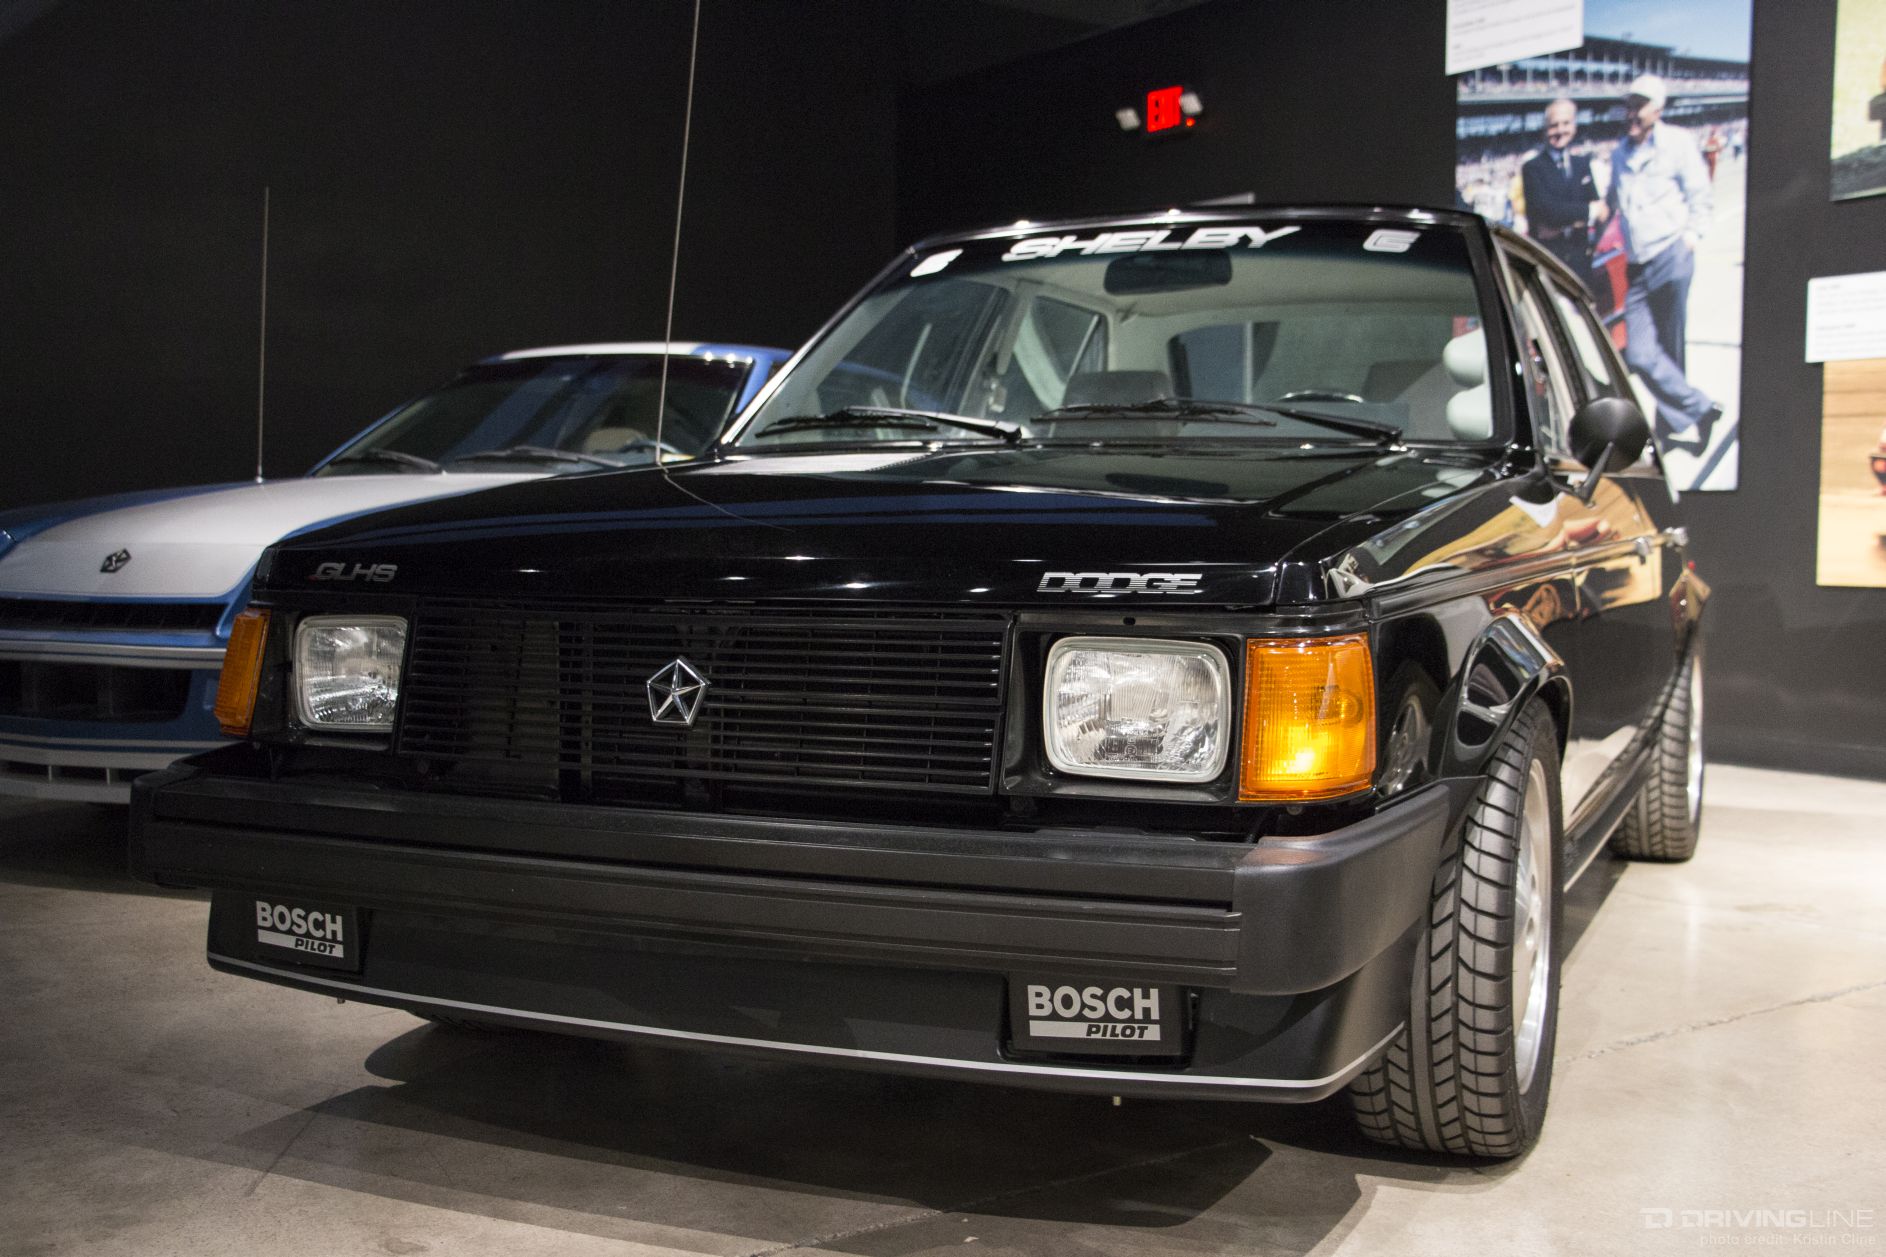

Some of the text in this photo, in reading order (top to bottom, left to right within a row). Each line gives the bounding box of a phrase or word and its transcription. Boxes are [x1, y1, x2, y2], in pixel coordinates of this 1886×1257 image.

[1001, 226, 1301, 262] SHELBY
[315, 562, 398, 582] GLHS
[1036, 571, 1203, 595] DODGE
[256, 900, 343, 941] BOSCH
[294, 937, 336, 955] PILOT
[1027, 984, 1160, 1020] BOSCH
[1086, 1023, 1148, 1039] PILOT
